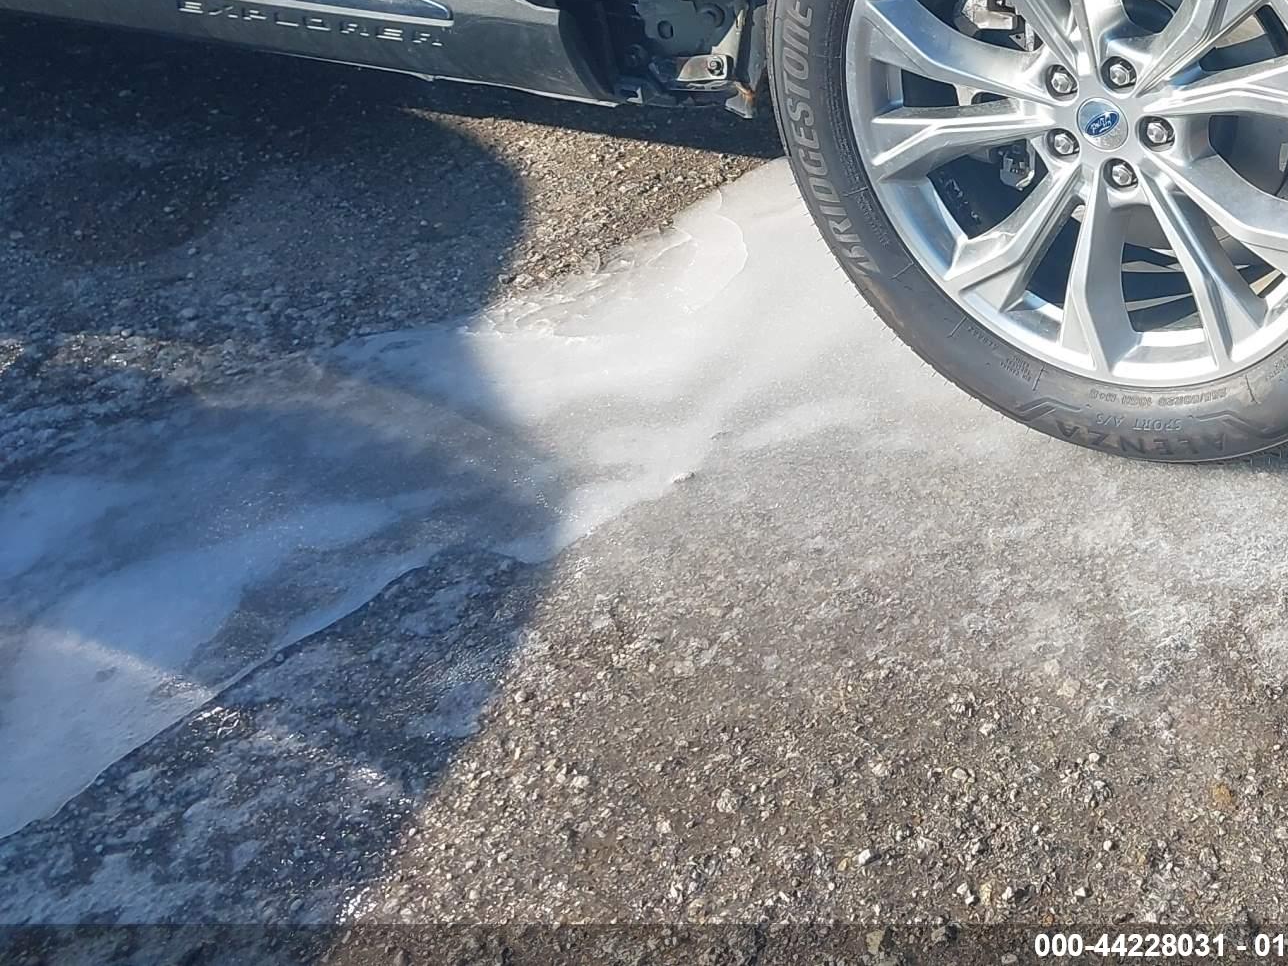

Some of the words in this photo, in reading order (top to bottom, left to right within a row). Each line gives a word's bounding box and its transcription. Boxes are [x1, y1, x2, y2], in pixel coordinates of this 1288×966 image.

[177, 0, 443, 48] EXPLORER
[782, 0, 881, 276] BRIDGESTONE
[1055, 419, 1227, 457] ALENZA
[1095, 412, 1126, 428] A/S
[1132, 418, 1184, 432] SPORT
